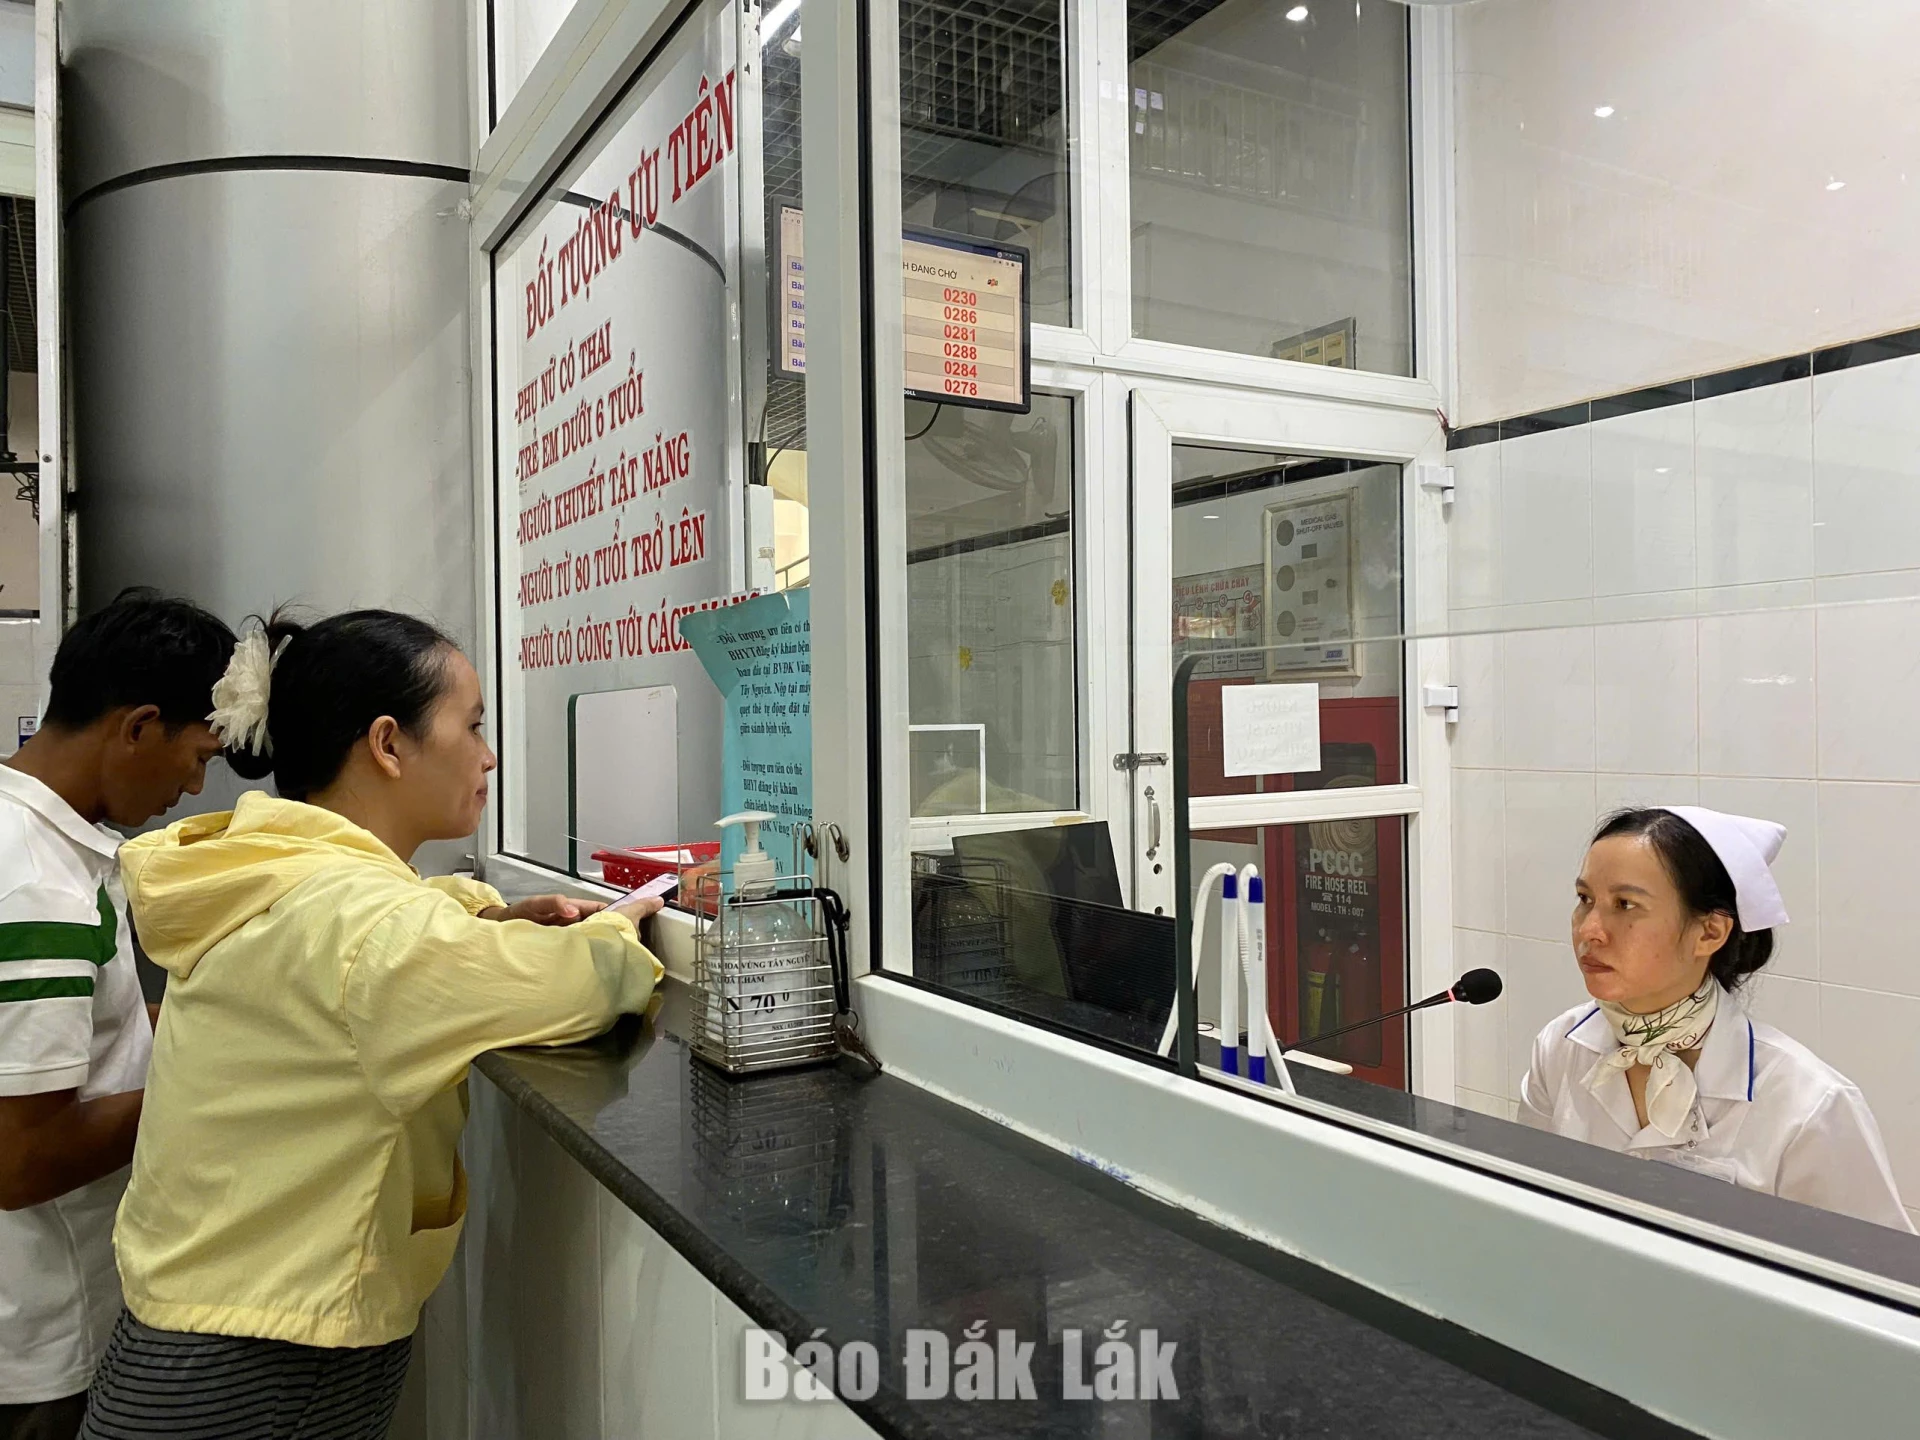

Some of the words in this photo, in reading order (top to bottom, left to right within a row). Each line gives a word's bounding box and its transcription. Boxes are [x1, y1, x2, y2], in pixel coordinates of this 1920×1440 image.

[526, 235, 555, 339] ĐỐI
[558, 188, 623, 306] TƯỢNG
[628, 149, 660, 239] ƯU
[668, 69, 735, 204] TIÊN
[911, 263, 936, 275] ĐANG
[937, 269, 957, 280] CHỜ
[944, 288, 977, 306] 0230
[944, 306, 977, 324] 0286
[944, 324, 977, 342] 0281
[944, 342, 977, 360] 0288
[541, 357, 556, 408] NỮ
[560, 339, 576, 393] CÓ
[579, 321, 611, 380] THAI
[944, 360, 978, 378] 0284
[944, 378, 978, 396] 0278
[542, 427, 559, 469] EM
[562, 399, 592, 458] DƯỚI
[596, 398, 604, 437] 6
[608, 351, 643, 430] TUỔI
[555, 459, 605, 530] KHUYẾT
[609, 451, 637, 513] TẬT
[643, 432, 690, 498] NẶNG
[556, 550, 572, 598] TỪ
[575, 553, 590, 593] 80
[594, 518, 628, 587] TUỔI
[632, 512, 664, 577] TRỞ
[669, 506, 705, 567] LÊN
[557, 619, 572, 665] CÓ
[577, 614, 612, 663] CÔNG
[616, 605, 642, 657] VỚI
[728, 647, 757, 661] BHYT
[1305, 874, 1322, 890] FIRE
[1325, 876, 1345, 892] HOSE
[1347, 879, 1368, 895] REEL
[1336, 894, 1352, 904] 114
[768, 956, 785, 967] TÂY
[750, 994, 776, 1016] 70
